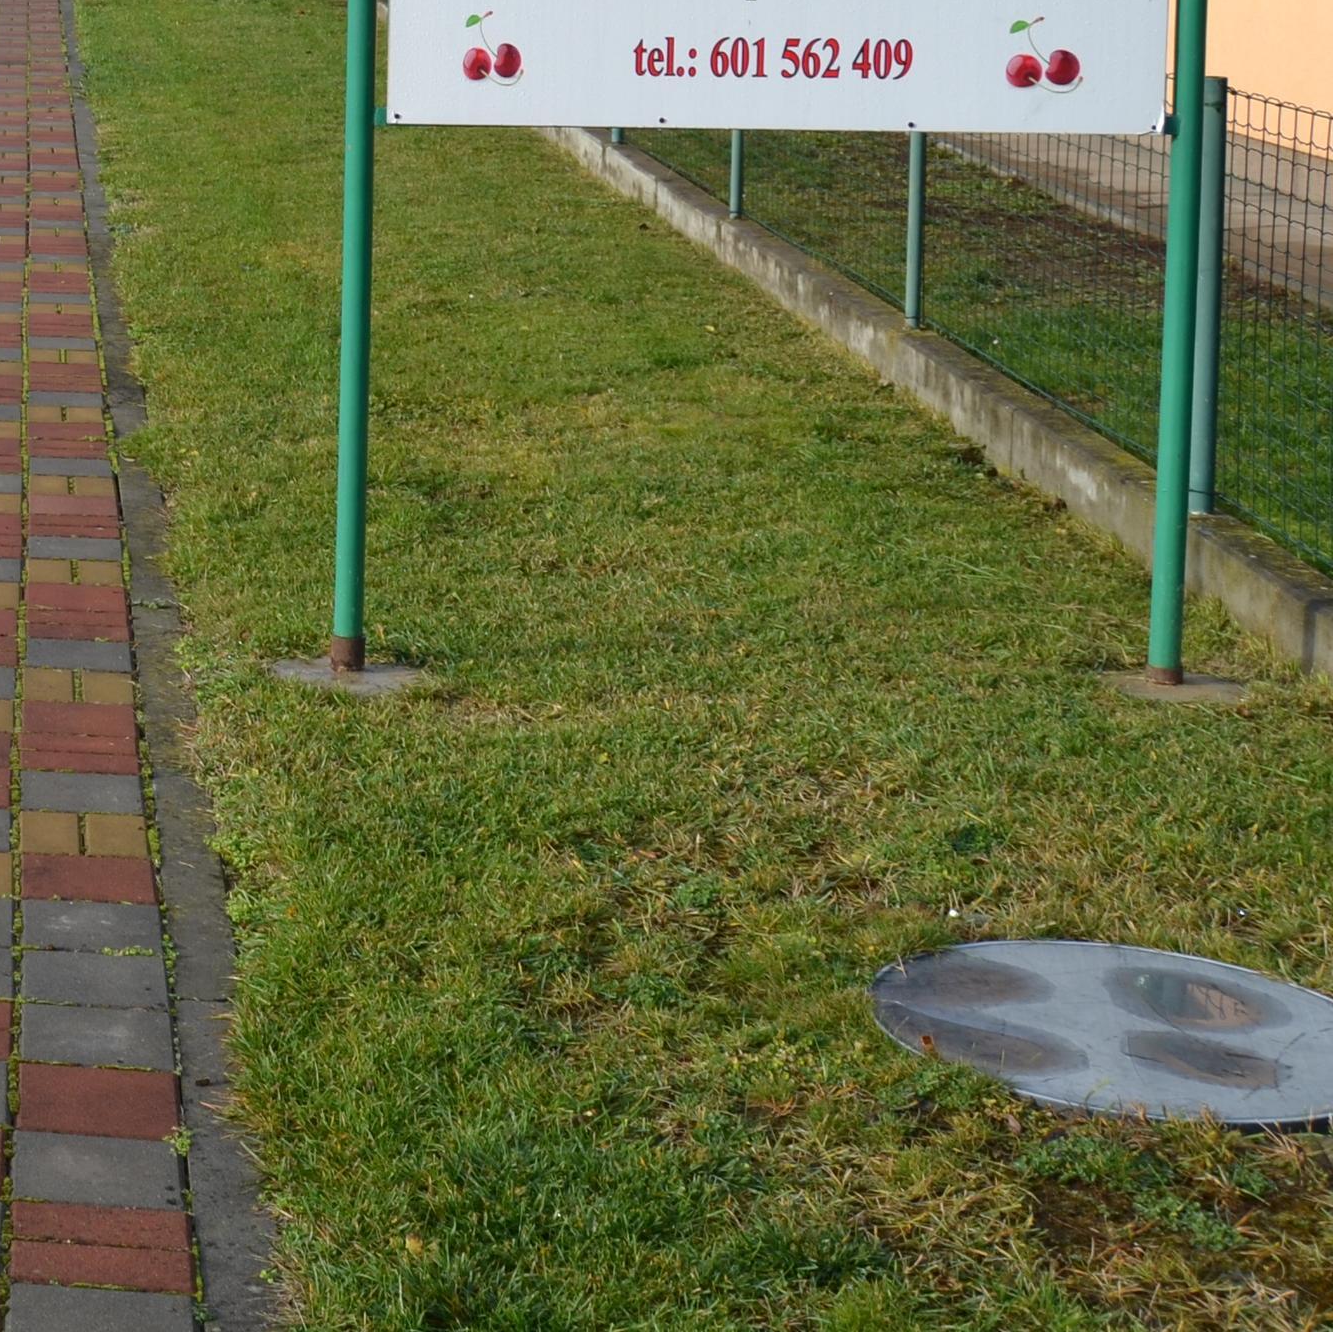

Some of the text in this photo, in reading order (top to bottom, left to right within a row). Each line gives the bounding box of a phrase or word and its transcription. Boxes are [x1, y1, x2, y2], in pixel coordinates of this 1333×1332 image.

[632, 36, 914, 81] tel.: 601 562 409
